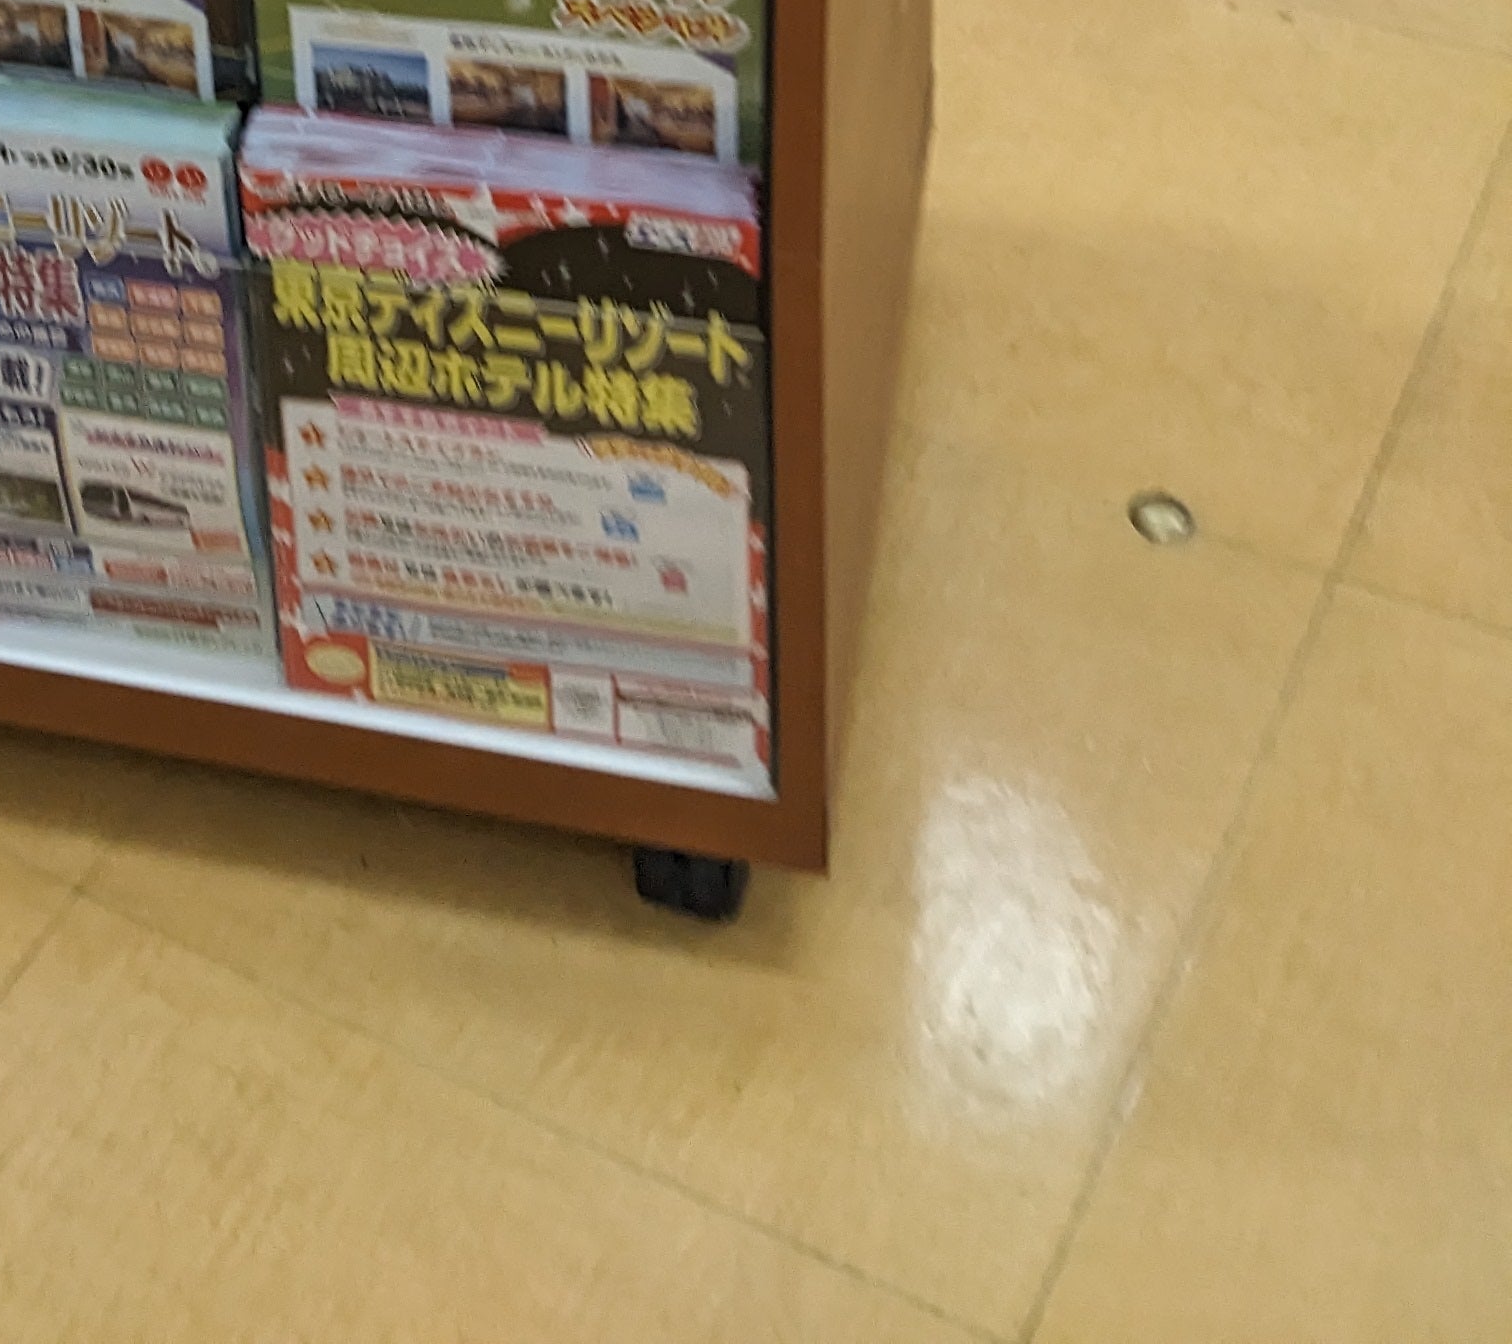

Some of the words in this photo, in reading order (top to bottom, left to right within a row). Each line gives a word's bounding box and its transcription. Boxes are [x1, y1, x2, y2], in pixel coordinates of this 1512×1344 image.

[271, 260, 754, 384] 東京ディズニーリゾート
[327, 334, 698, 439] 周辺ホテル特集
